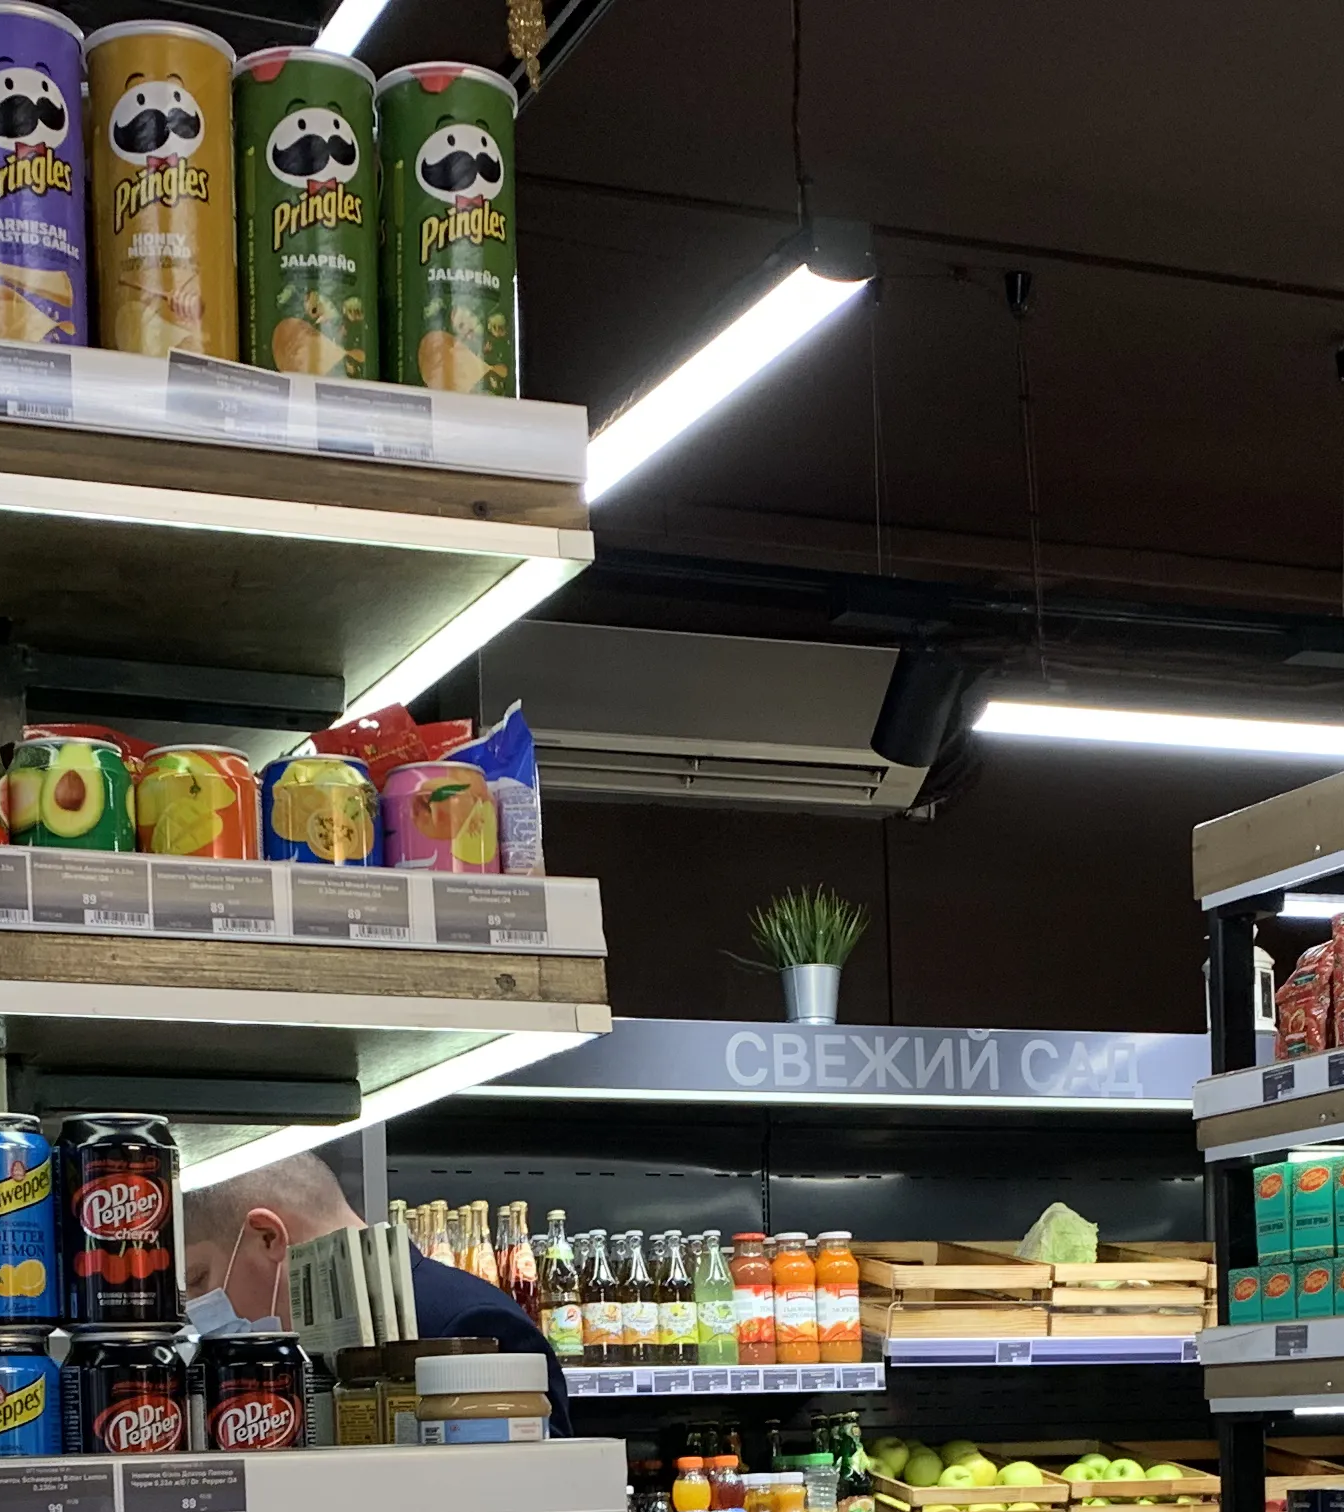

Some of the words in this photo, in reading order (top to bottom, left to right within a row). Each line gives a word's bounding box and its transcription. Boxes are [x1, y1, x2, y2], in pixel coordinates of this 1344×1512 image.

[114, 159, 209, 233] Pringles
[273, 184, 362, 251] Pringles
[420, 200, 506, 264] Pringles
[725, 1028, 1001, 1091] СВЕЖИЙ
[1020, 1039, 1144, 1098] САД
[82, 1190, 160, 1226] Pepper
[109, 1181, 133, 1208] Dr
[114, 1226, 160, 1245] cherry
[110, 1411, 180, 1450] Pepper
[139, 1404, 162, 1428] Dr
[217, 1408, 290, 1446] Pepper
[246, 1401, 272, 1425] Dr
[182, 1498, 196, 1509] 89
